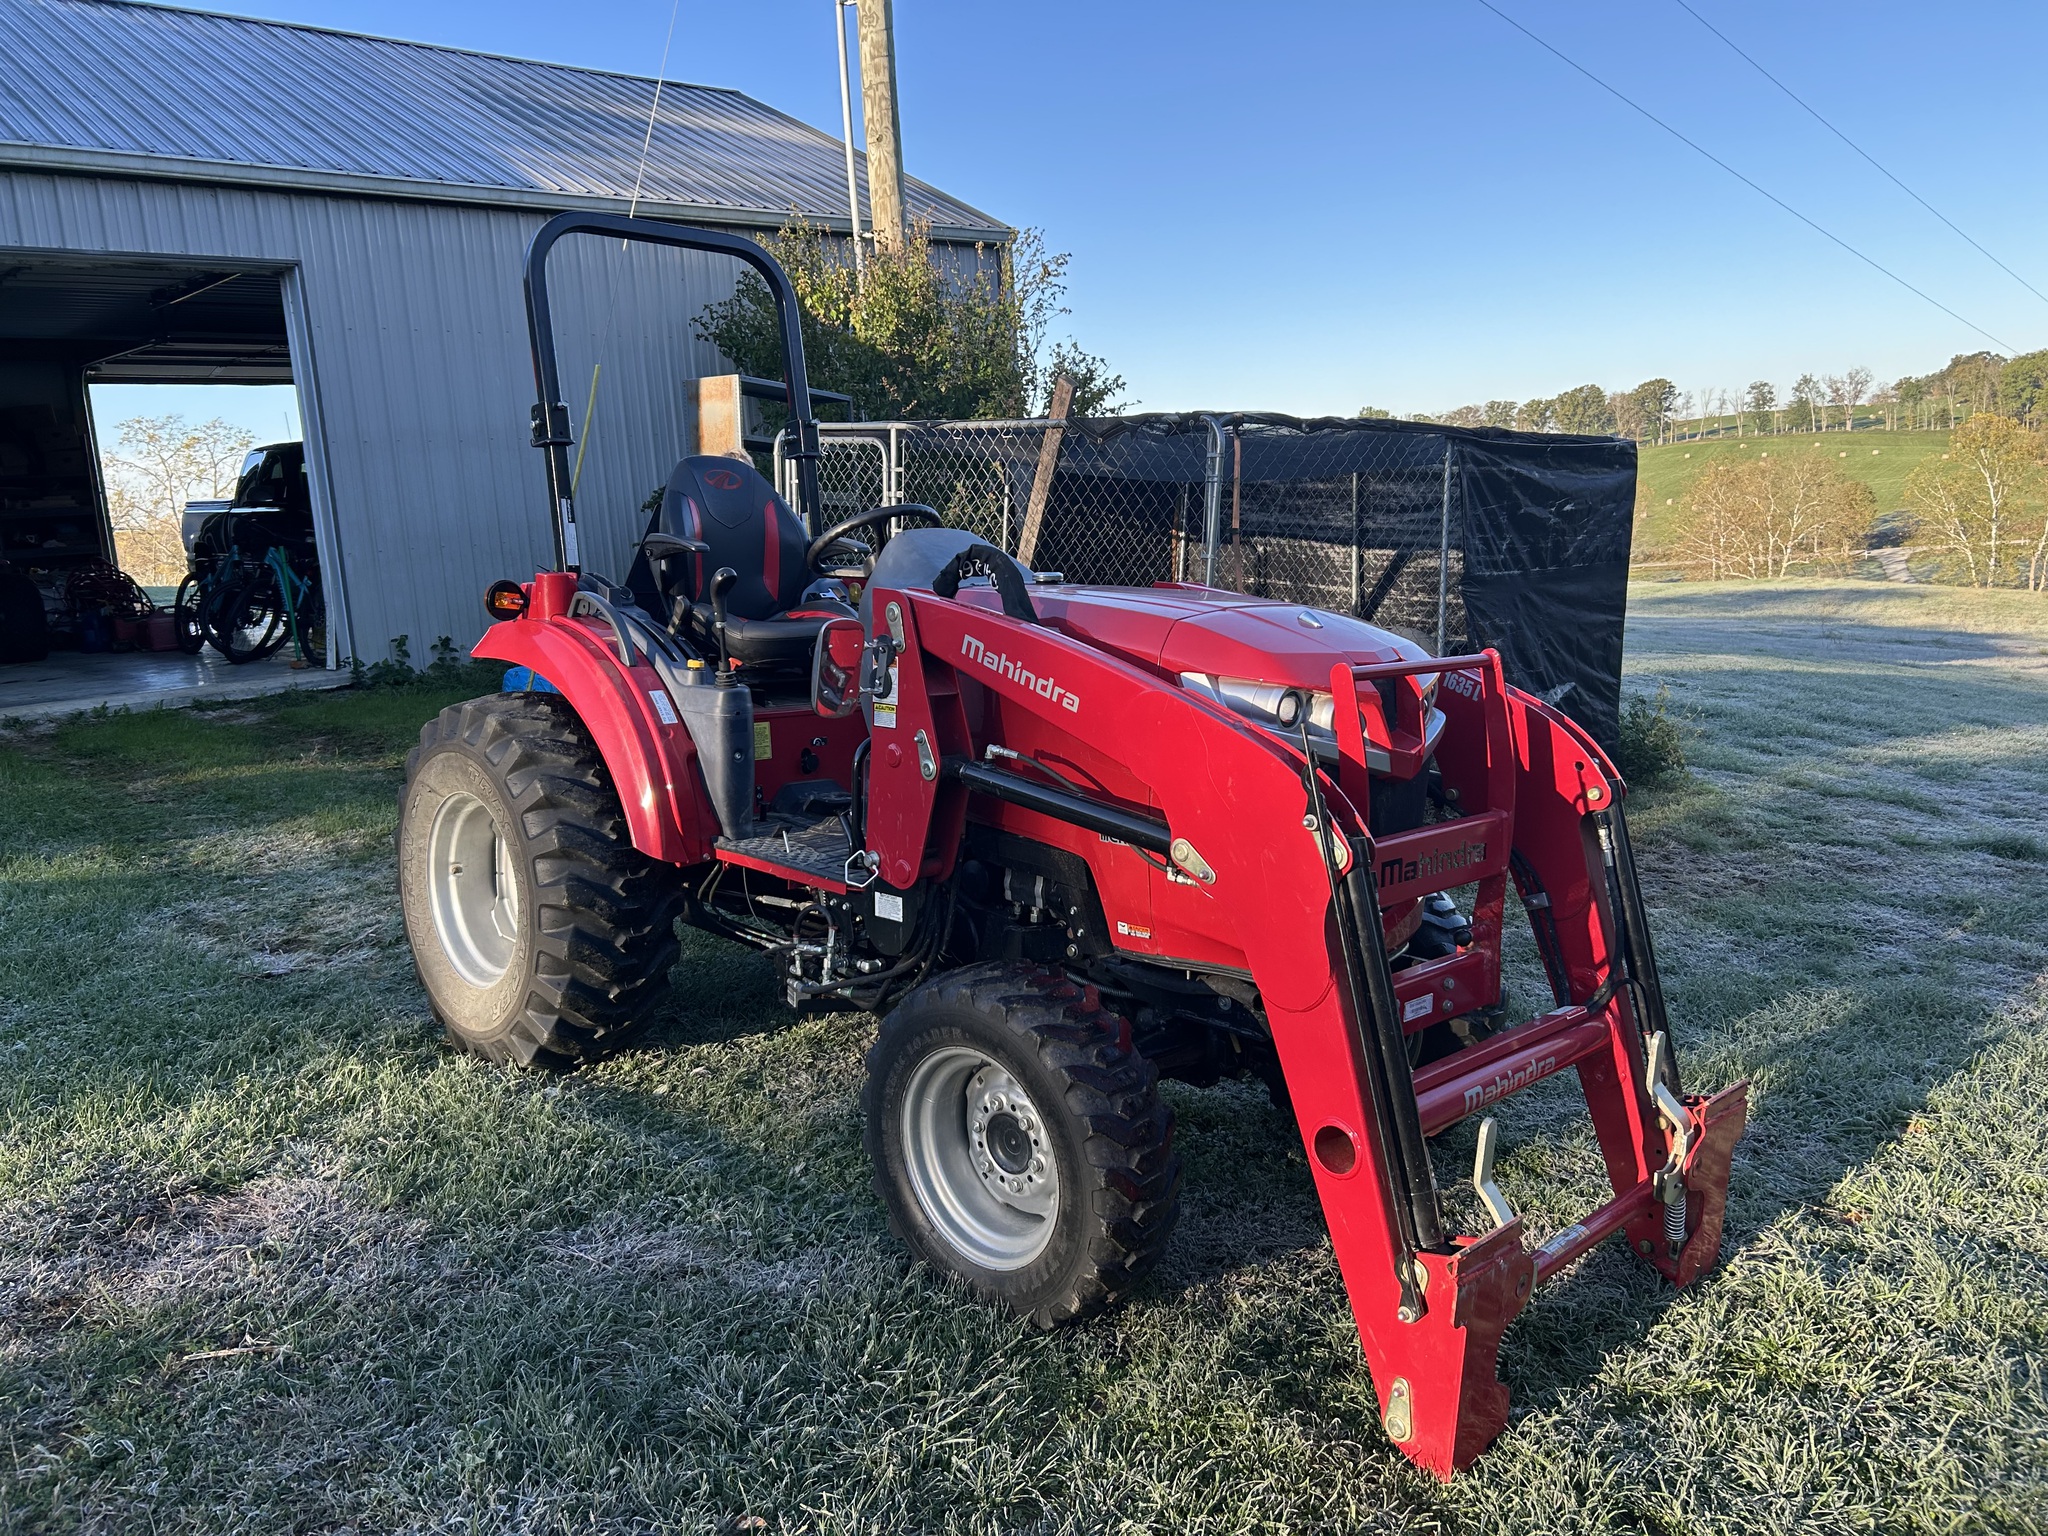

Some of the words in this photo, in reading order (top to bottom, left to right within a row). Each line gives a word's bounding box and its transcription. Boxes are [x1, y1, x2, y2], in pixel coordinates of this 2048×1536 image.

[961, 634, 1081, 713] Mahindra
[1443, 671, 1474, 697] 1635
[1380, 840, 1487, 888] Mahindra
[1463, 1056, 1556, 1114] Mahindra
